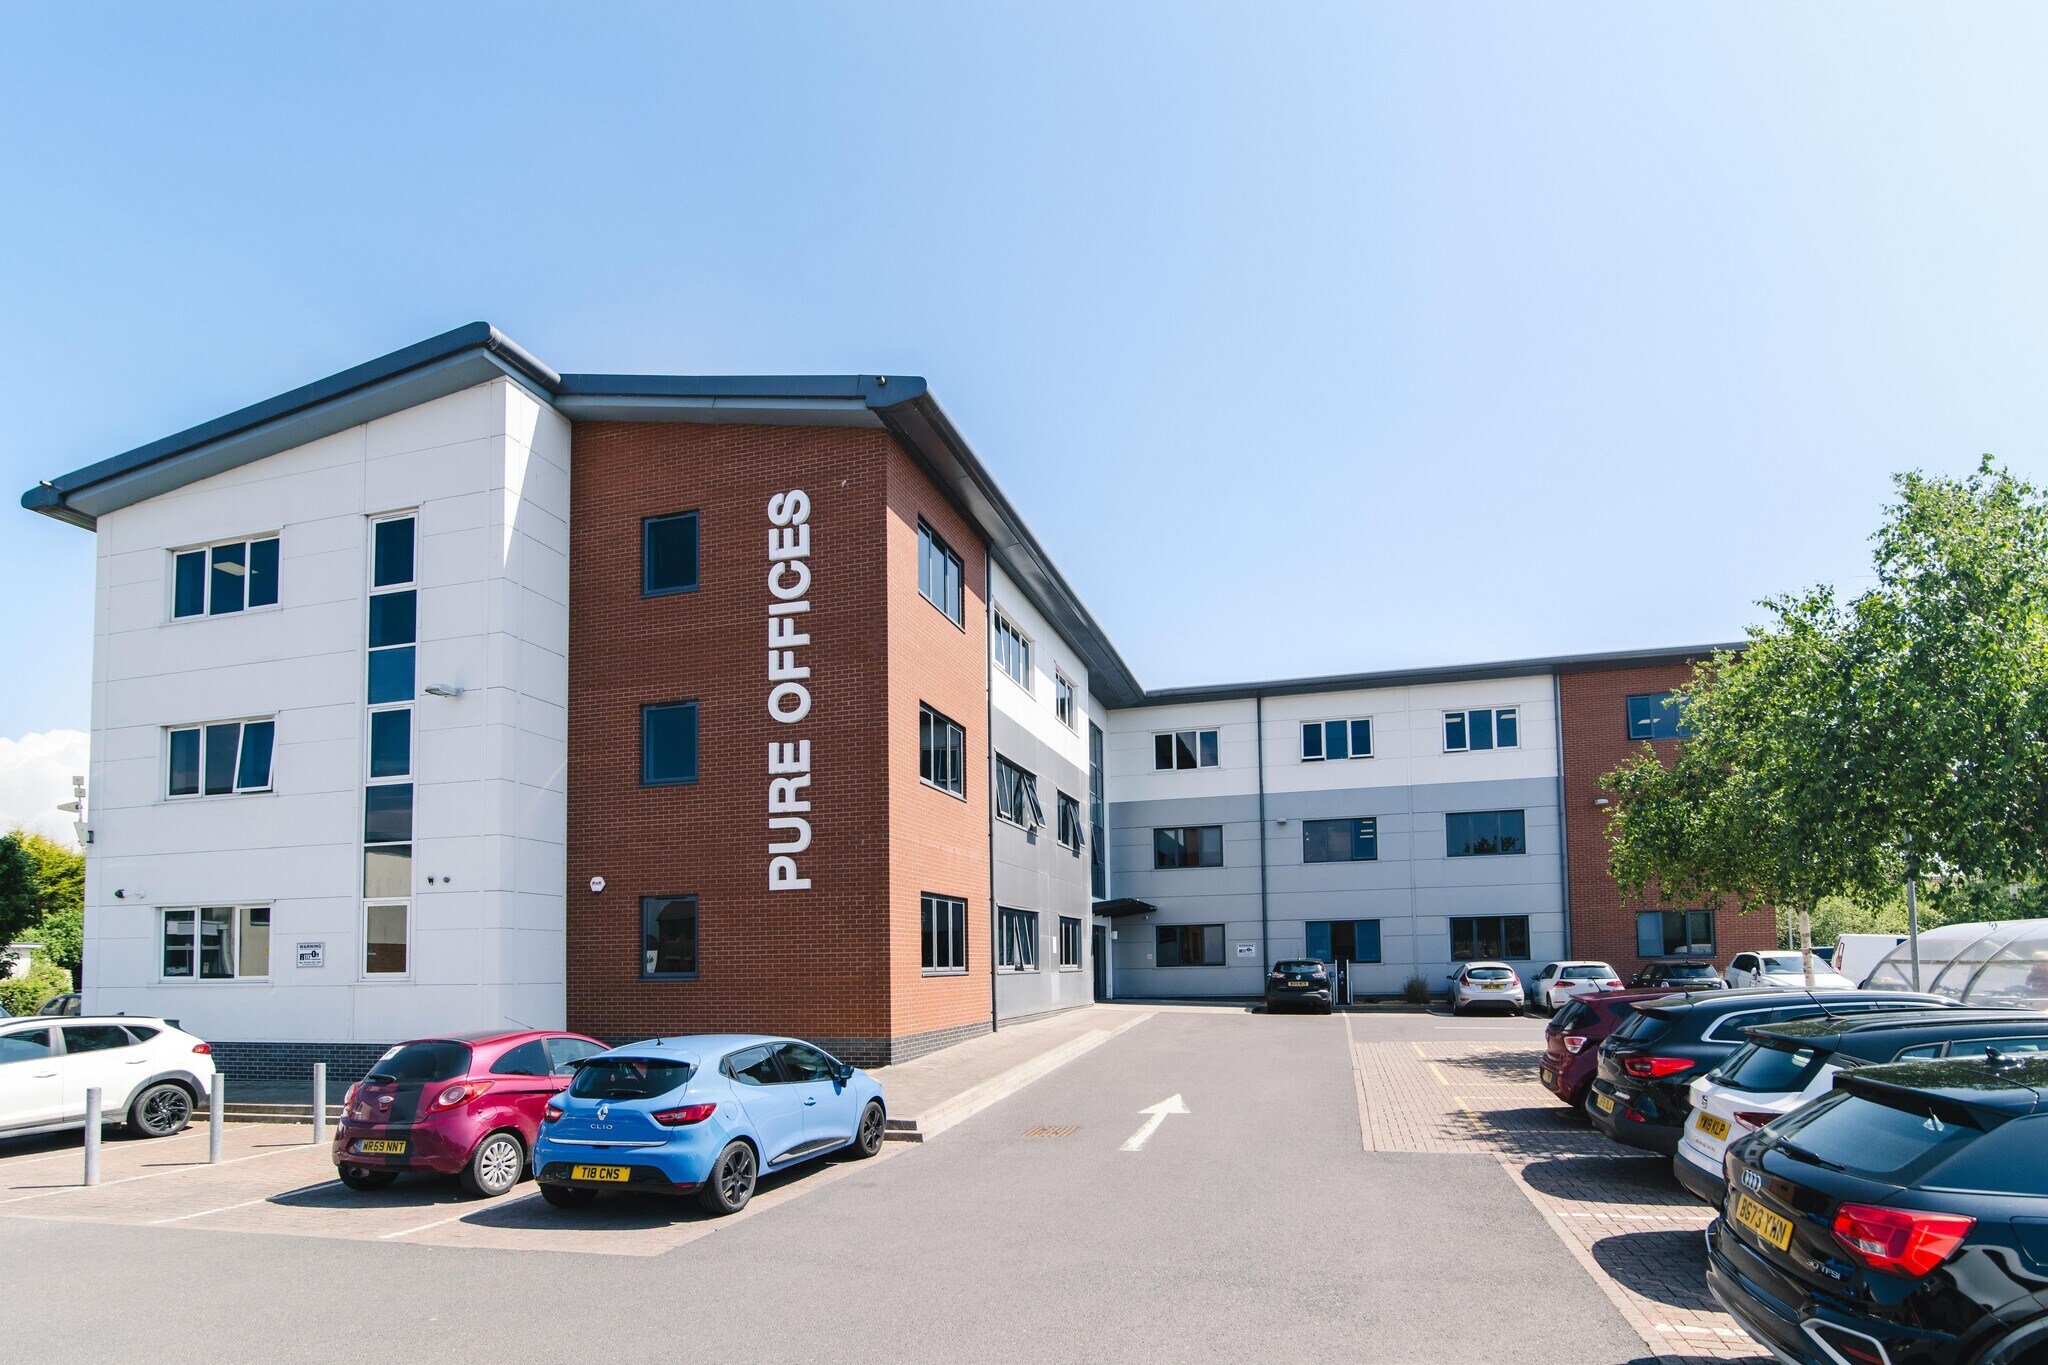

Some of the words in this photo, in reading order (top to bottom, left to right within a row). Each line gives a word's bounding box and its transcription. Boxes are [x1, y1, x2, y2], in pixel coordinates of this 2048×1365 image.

[767, 489, 811, 723] OFFICES
[768, 739, 811, 890] PURE
[362, 1141, 385, 1152] WR59
[386, 1142, 405, 1152] NNT
[582, 1167, 597, 1178] T18
[599, 1168, 621, 1179] CNS
[1820, 1264, 1841, 1280] TFSI
